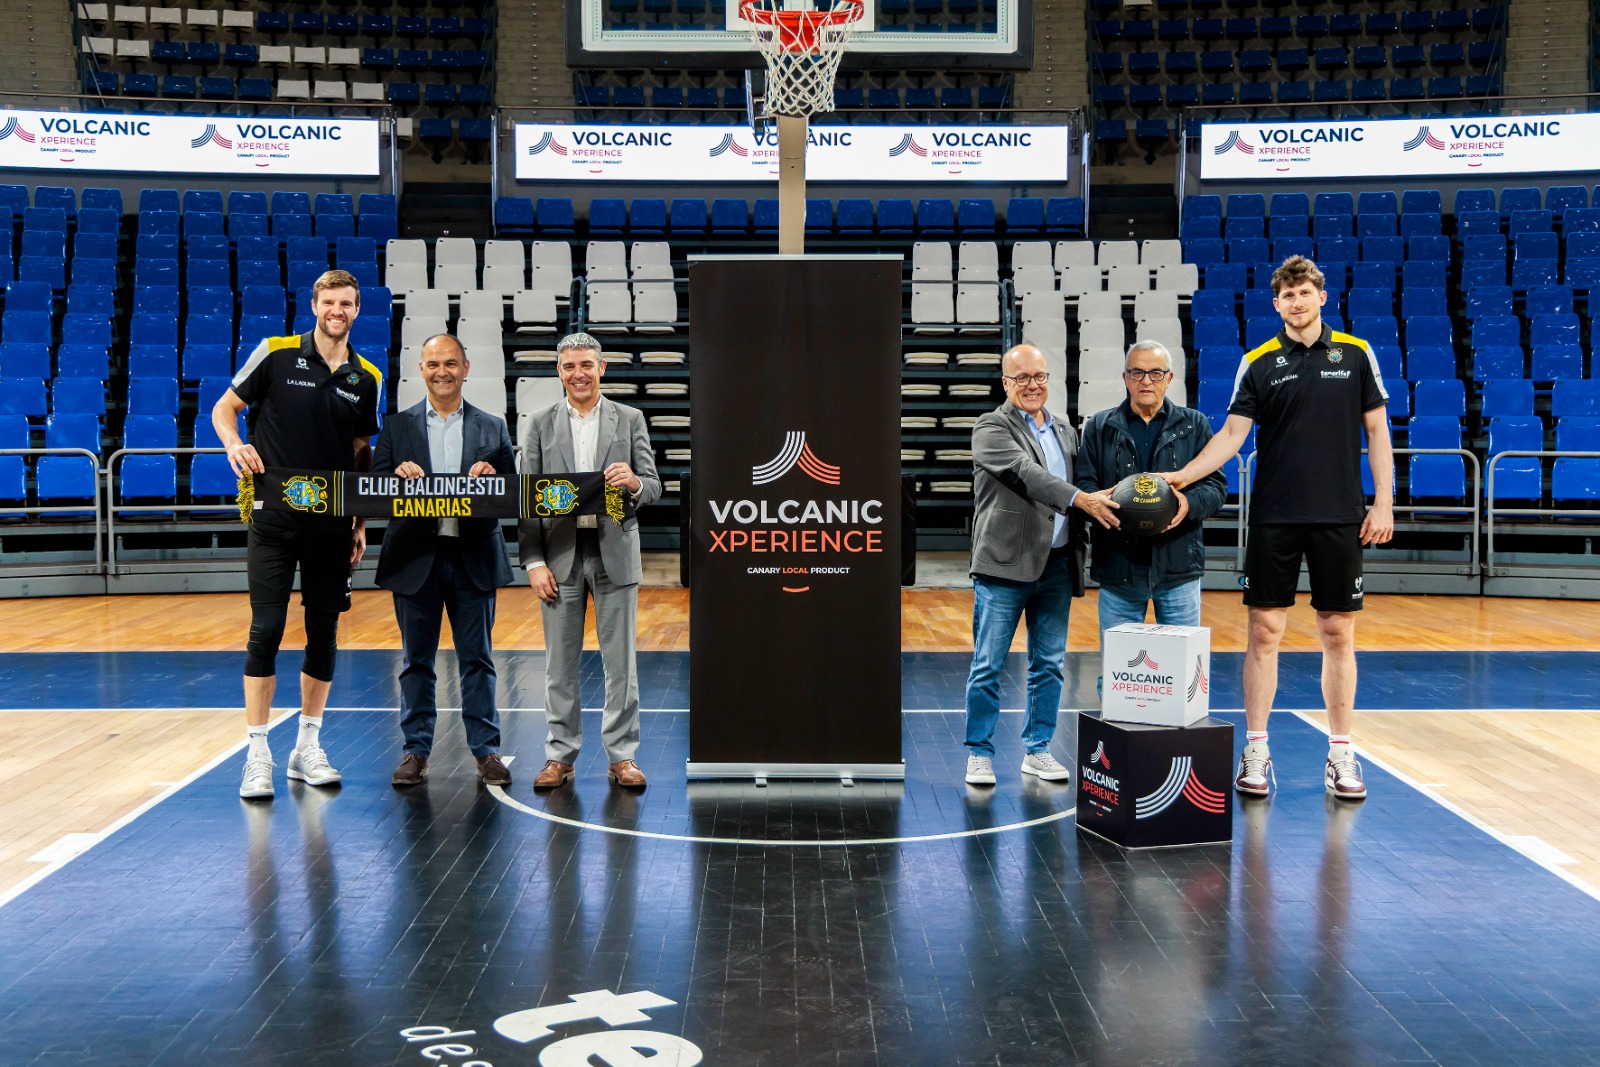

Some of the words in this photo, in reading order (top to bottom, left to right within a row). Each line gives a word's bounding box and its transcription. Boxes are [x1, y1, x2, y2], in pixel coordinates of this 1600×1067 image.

[40, 118, 151, 137] VOLCANIC
[236, 124, 342, 141] VOLCANIC
[1259, 127, 1365, 144] VOLCANIC
[1450, 121, 1561, 140] VOLCANIC
[40, 136, 97, 146] XPERIENCE
[236, 142, 290, 151] XPERIENCE
[572, 131, 673, 147] VOLCANIC
[932, 132, 1032, 148] VOLCANIC
[1449, 141, 1505, 151] XPERIENCE
[572, 149, 623, 157] XPERIENCE
[932, 150, 982, 158] XPERIENCE
[1258, 146, 1311, 155] XPERIENCE
[358, 476, 400, 496] CLUB
[404, 476, 506, 496] BALONCESTO
[393, 497, 472, 517] CANARIAS
[708, 499, 883, 525] VOLCANIC
[709, 530, 883, 553] XPERIENCE
[1112, 671, 1173, 685] VOLCANIC
[1112, 682, 1173, 696] XPERIENCE
[1082, 765, 1119, 791] VOLCANIC
[1081, 780, 1119, 805] XPERIENCE
